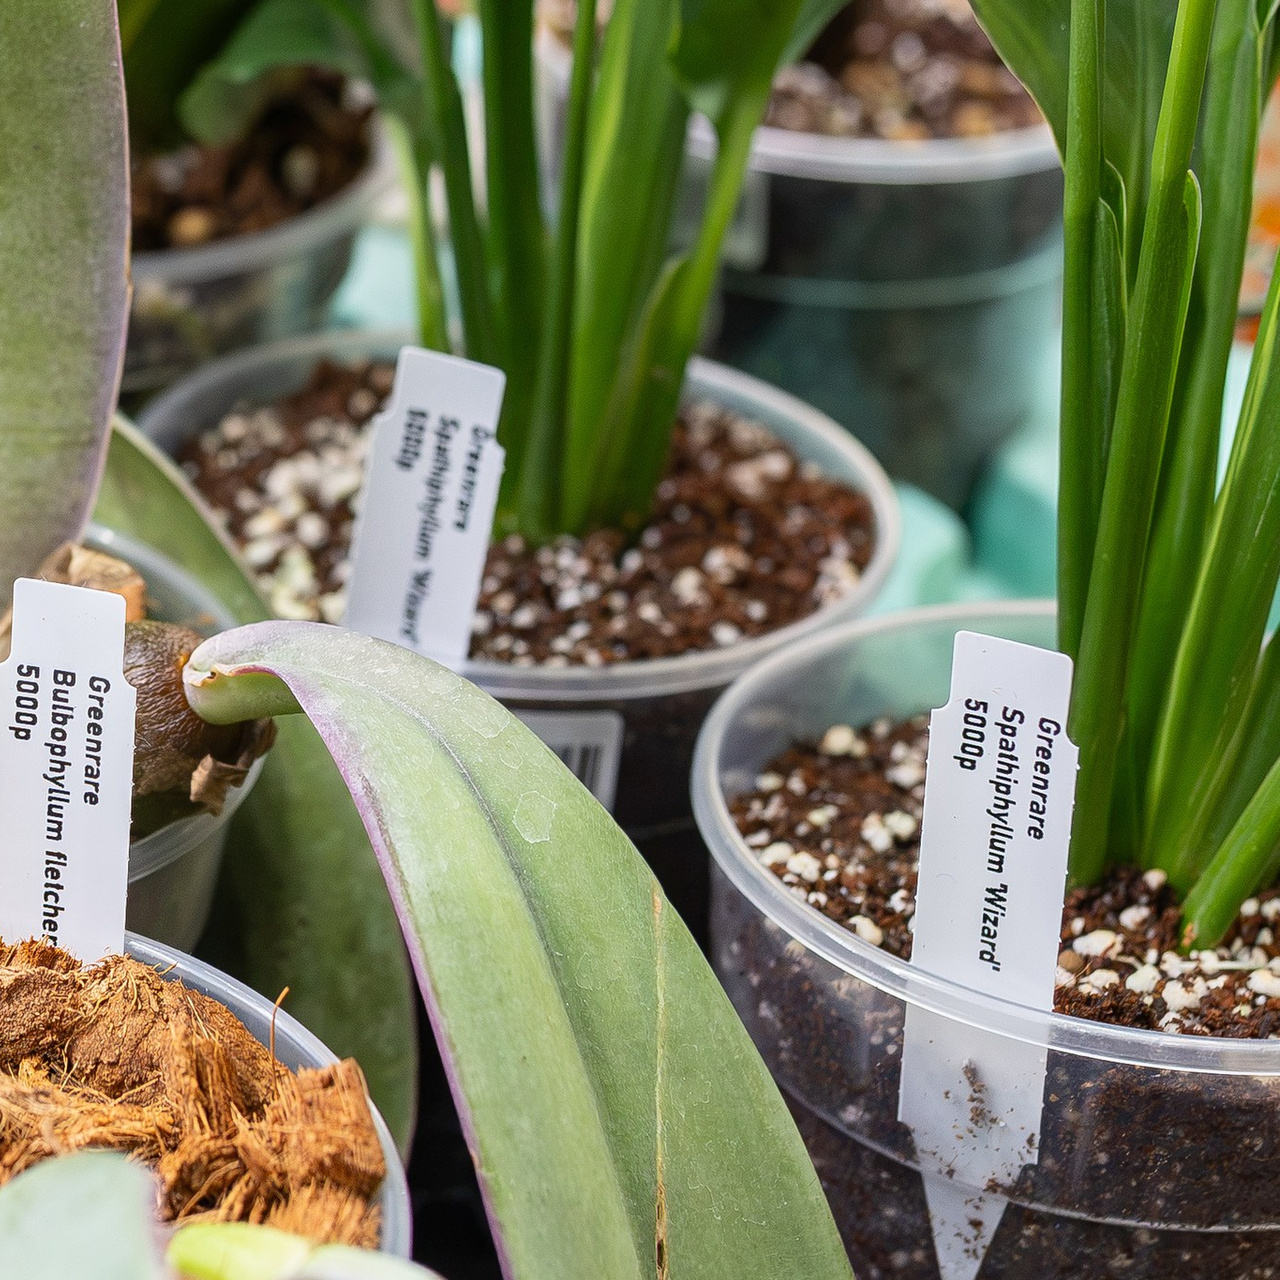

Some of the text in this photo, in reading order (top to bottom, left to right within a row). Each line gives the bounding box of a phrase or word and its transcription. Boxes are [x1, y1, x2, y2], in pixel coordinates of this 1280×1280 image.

[9, 663, 40, 741] 5000p
[43, 668, 76, 841] Bulbophyllum
[83, 675, 111, 807] Greenrare
[953, 697, 989, 772] 5000p
[985, 705, 1025, 874] Spathiphyllum
[1027, 717, 1061, 841] Greenrare
